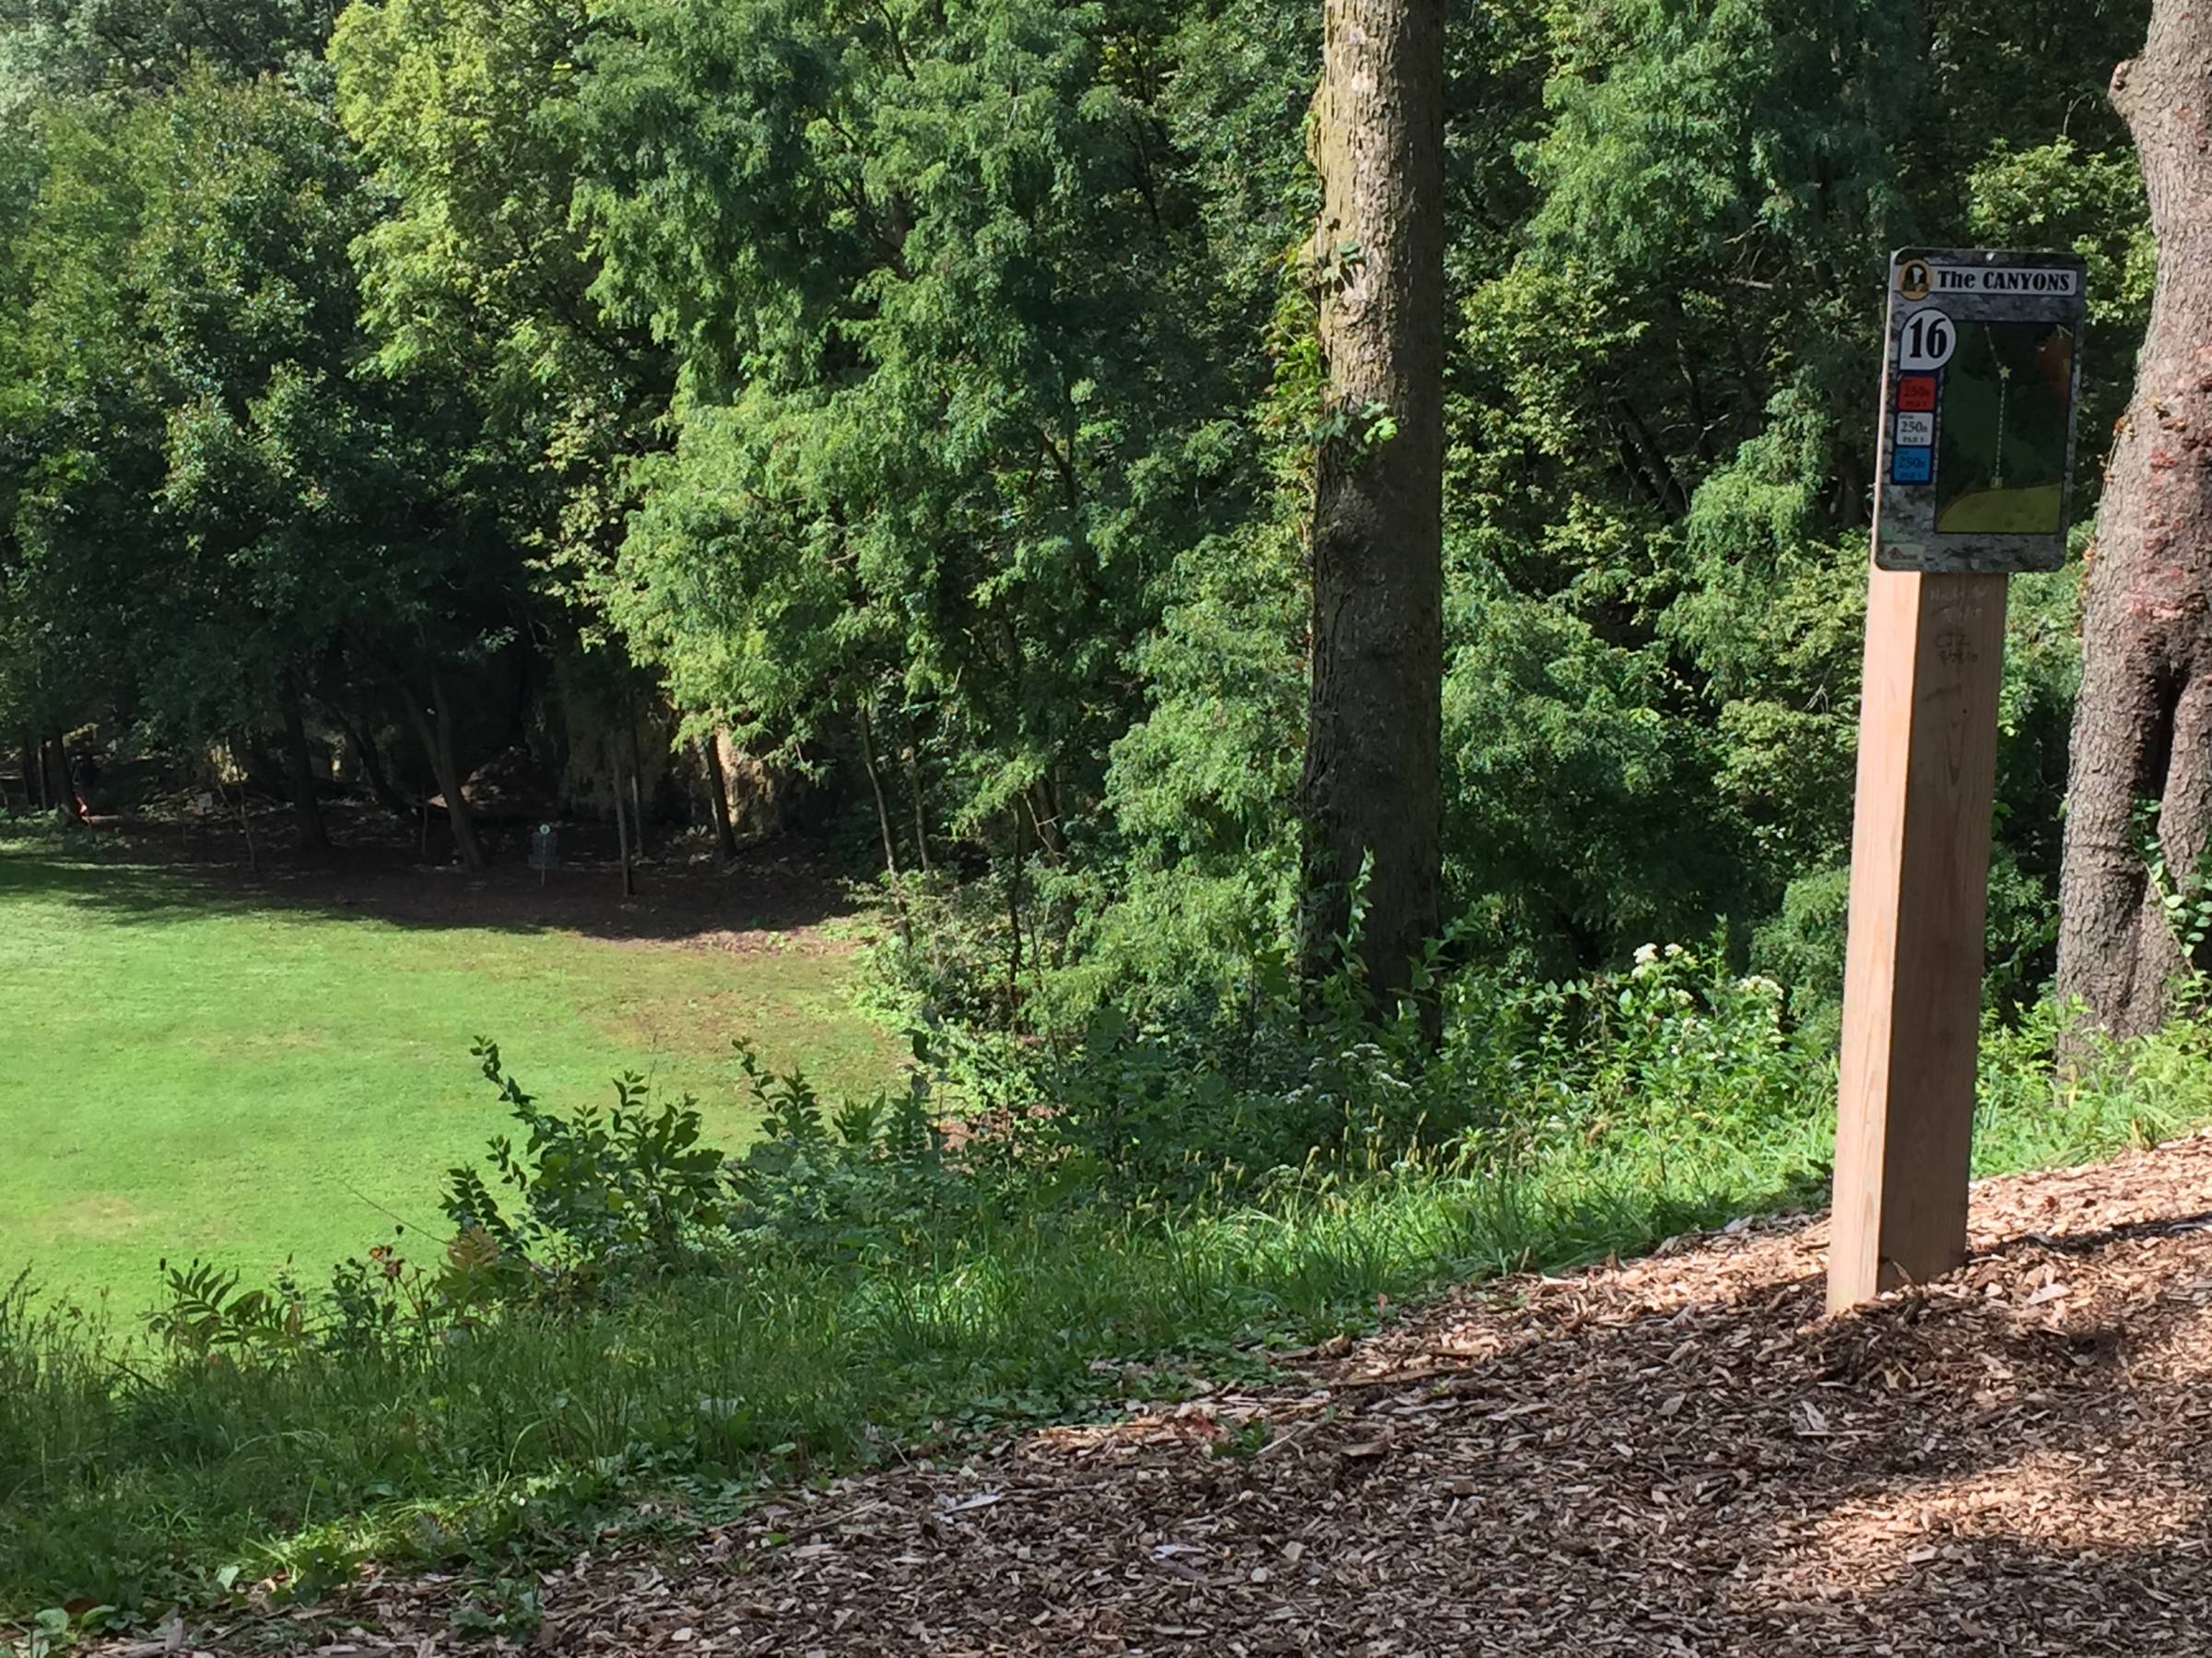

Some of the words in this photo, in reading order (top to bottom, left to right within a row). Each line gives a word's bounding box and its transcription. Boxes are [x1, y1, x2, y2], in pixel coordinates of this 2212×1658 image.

[1937, 270, 1975, 288] The
[1983, 271, 2070, 291] CANYONS
[1909, 317, 1947, 359] 16
